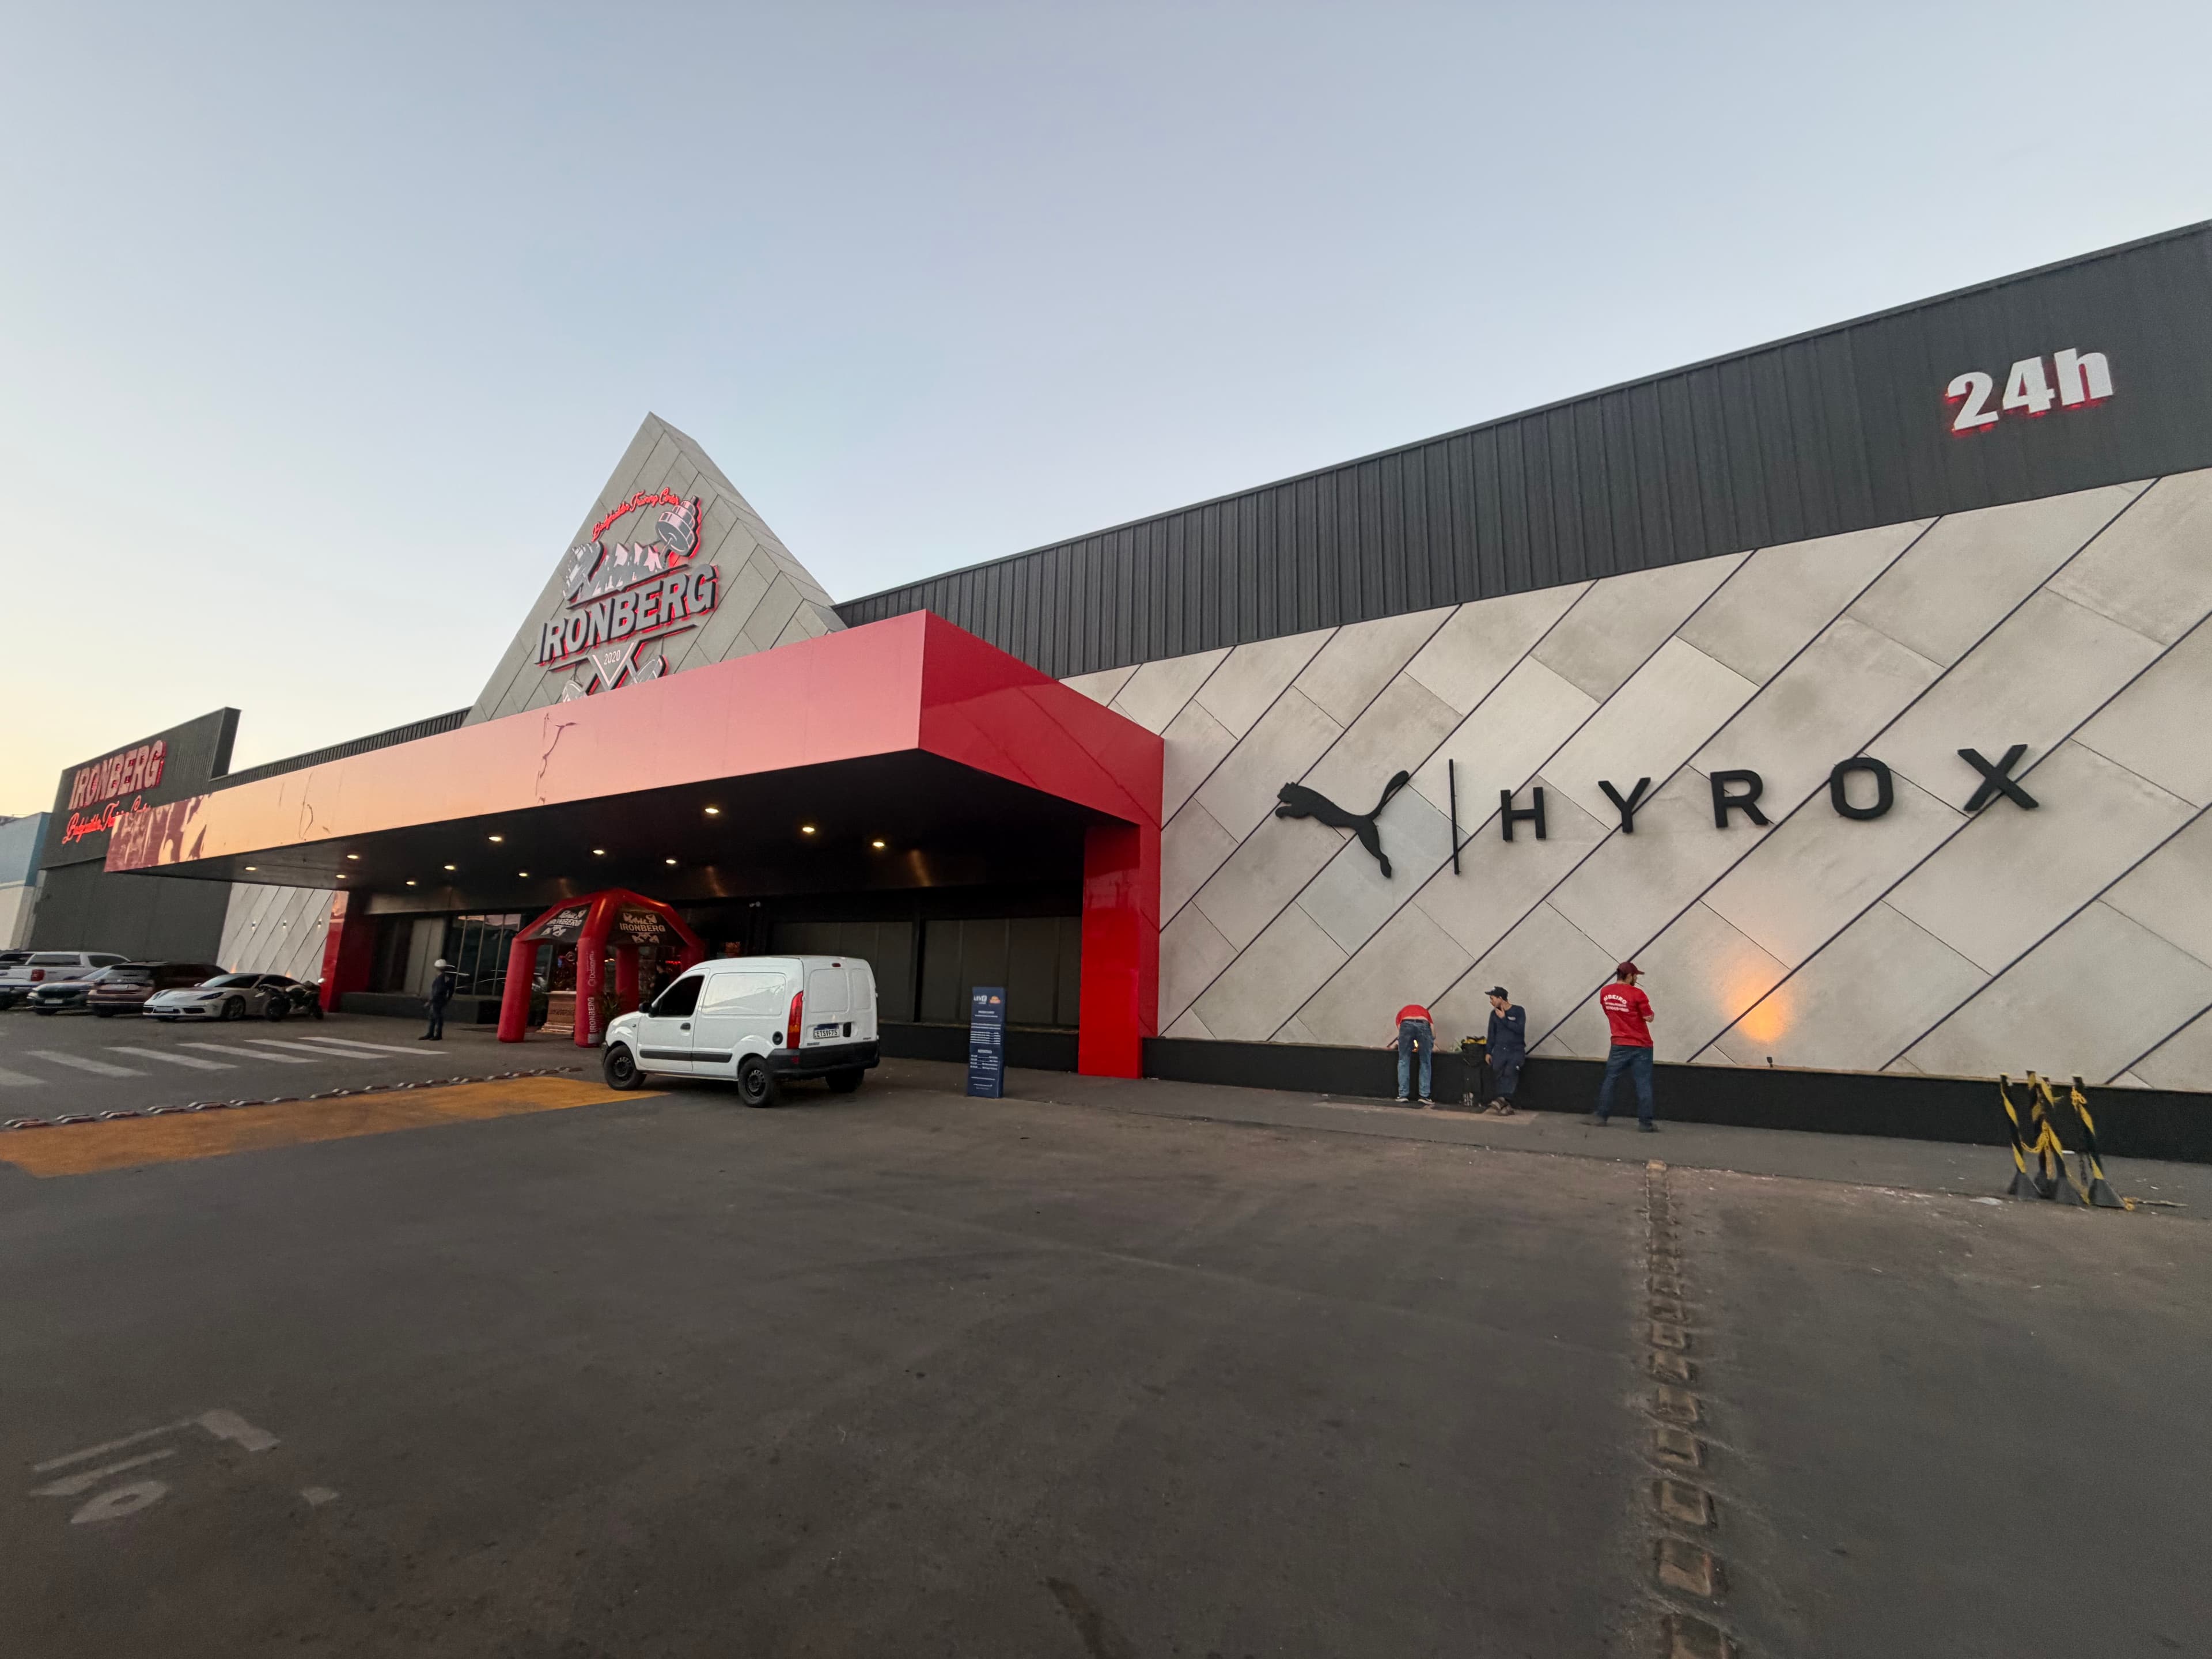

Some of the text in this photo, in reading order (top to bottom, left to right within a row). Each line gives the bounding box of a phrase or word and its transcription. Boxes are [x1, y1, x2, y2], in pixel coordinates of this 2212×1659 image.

[1947, 347, 2113, 431] 24h
[534, 564, 718, 664] IRONBERG
[604, 650, 620, 665] 2020
[68, 740, 166, 810] IRONBERG
[1501, 744, 2039, 842] HYROX
[619, 923, 666, 932] IRONBERG
